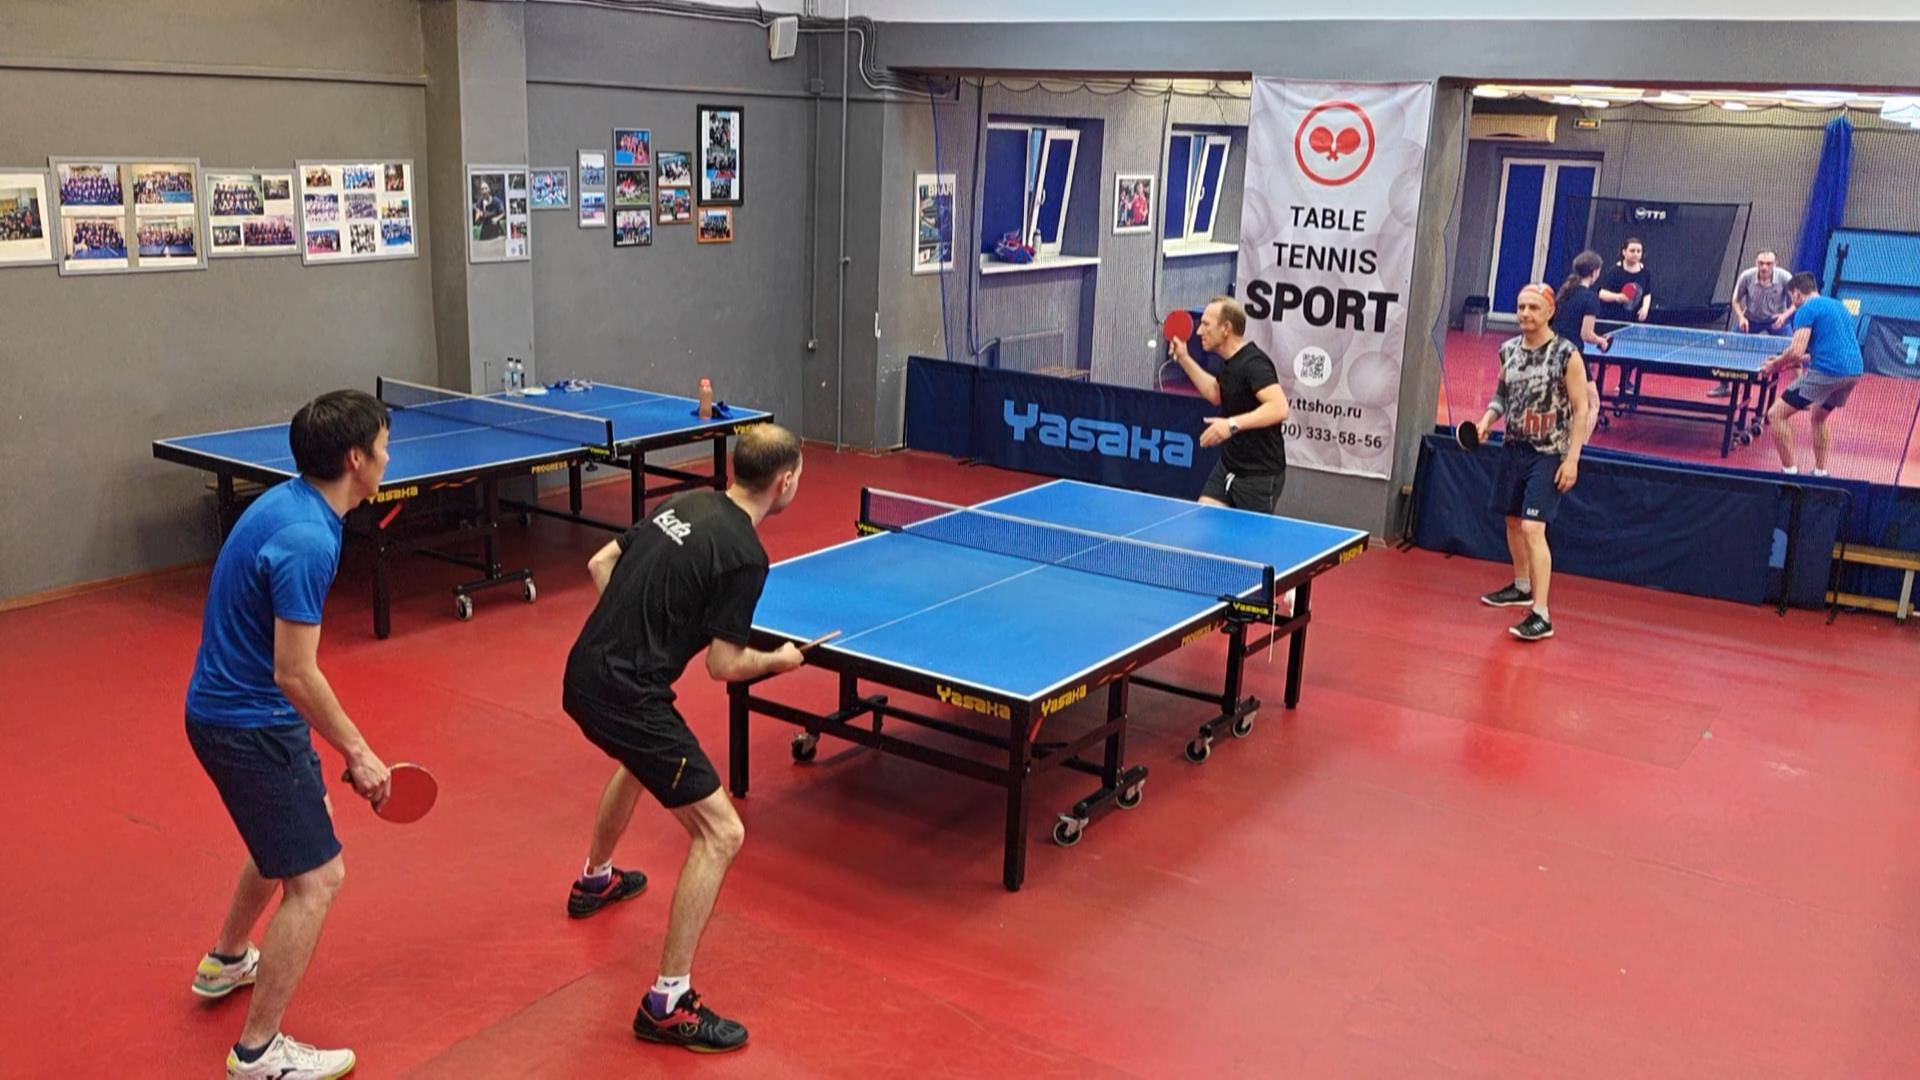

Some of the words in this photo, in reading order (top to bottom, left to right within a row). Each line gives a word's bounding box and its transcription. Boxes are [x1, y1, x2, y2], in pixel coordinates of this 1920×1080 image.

[1290, 205, 1367, 232] TABLE
[1272, 242, 1378, 275] TENNIS
[1244, 279, 1400, 333] SPORT
[1003, 399, 1194, 469] Yasaka
[1281, 423, 1302, 440] 00)
[1306, 427, 1383, 449] 333-58-56
[1232, 602, 1269, 615] Yasaka
[936, 684, 1011, 720] Yasaka
[1041, 684, 1087, 717] Yasaka
